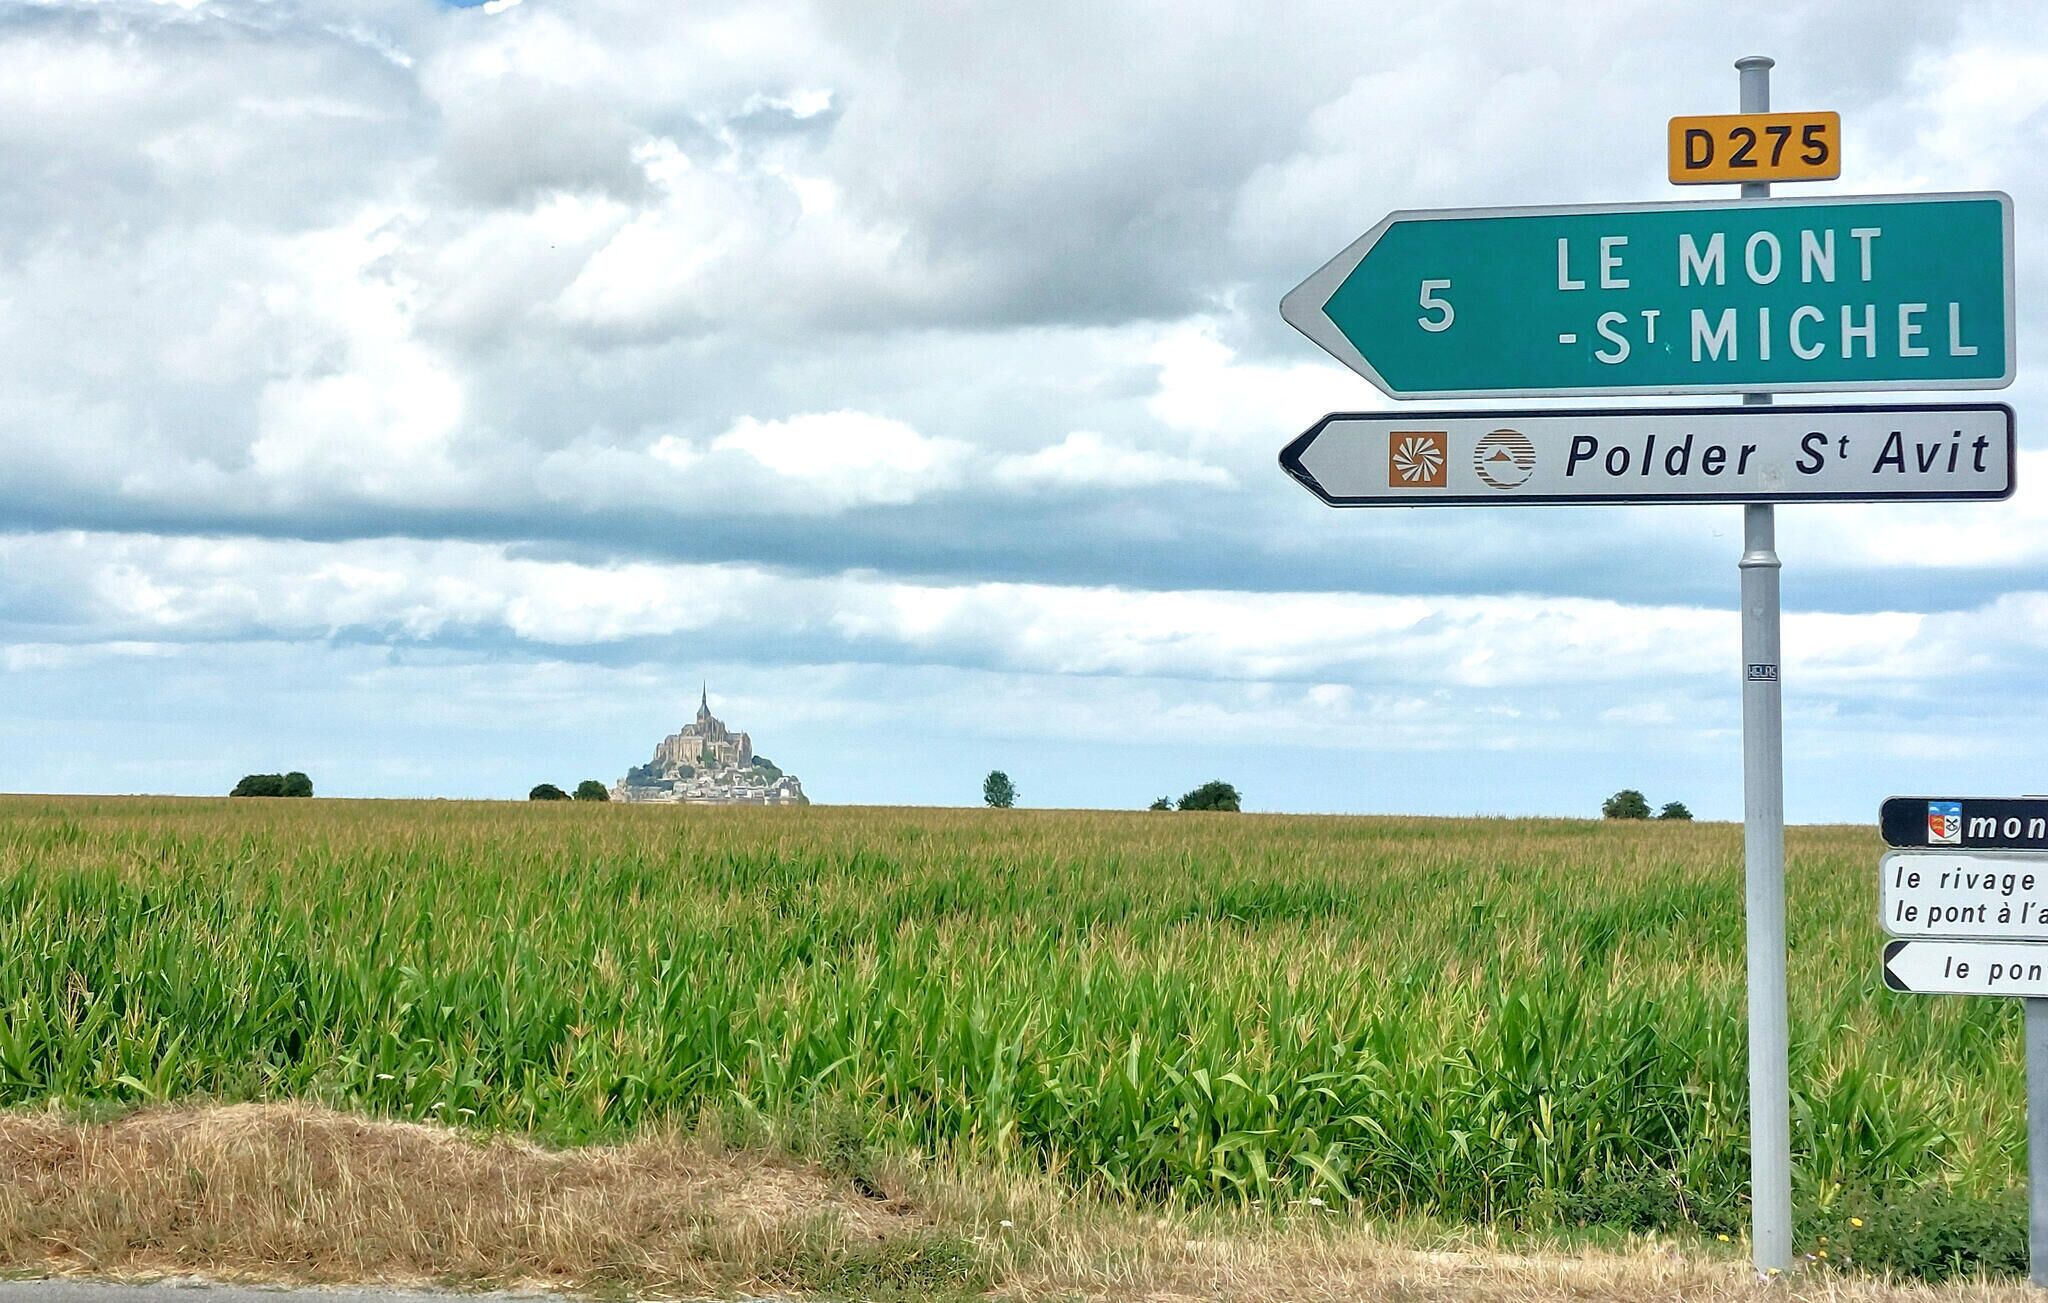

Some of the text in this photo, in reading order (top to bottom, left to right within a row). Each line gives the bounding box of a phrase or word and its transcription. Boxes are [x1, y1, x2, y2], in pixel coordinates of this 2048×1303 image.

[1558, 227, 1881, 290] LE MONT
[1418, 279, 1455, 332] 5
[1691, 302, 1978, 362] MICHEL
[1565, 430, 1990, 477] Polder St Avit
[1895, 866, 2035, 897] le rivage
[1896, 899, 1918, 922] le
[1927, 903, 1987, 929] pont
[1997, 901, 2011, 924] à
[1944, 956, 2048, 986] le pon
